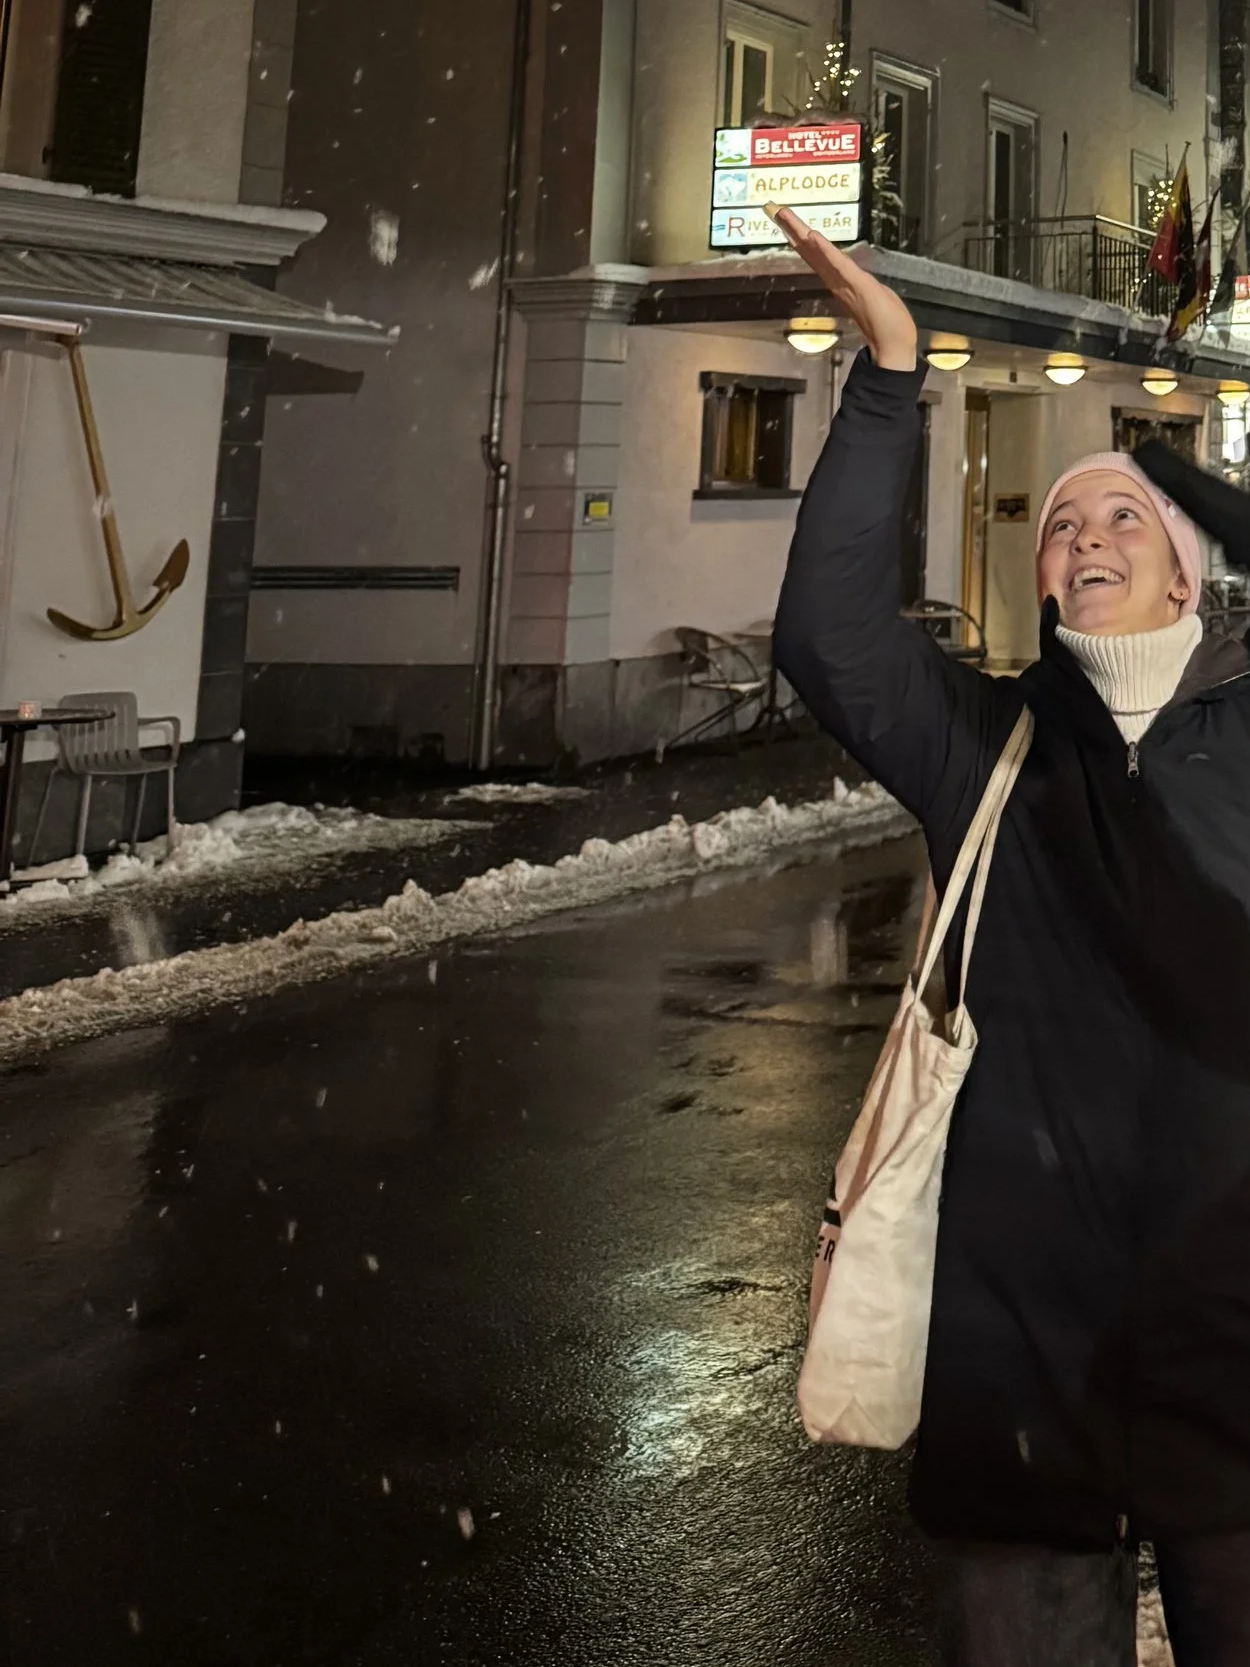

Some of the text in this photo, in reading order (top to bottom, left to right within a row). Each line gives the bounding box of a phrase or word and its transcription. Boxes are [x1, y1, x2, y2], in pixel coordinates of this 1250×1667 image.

[755, 133, 856, 154] BELLEVUE
[788, 131, 822, 140] HOTEL
[755, 174, 849, 191] ALPLODGE
[727, 216, 817, 238] RIVEE
